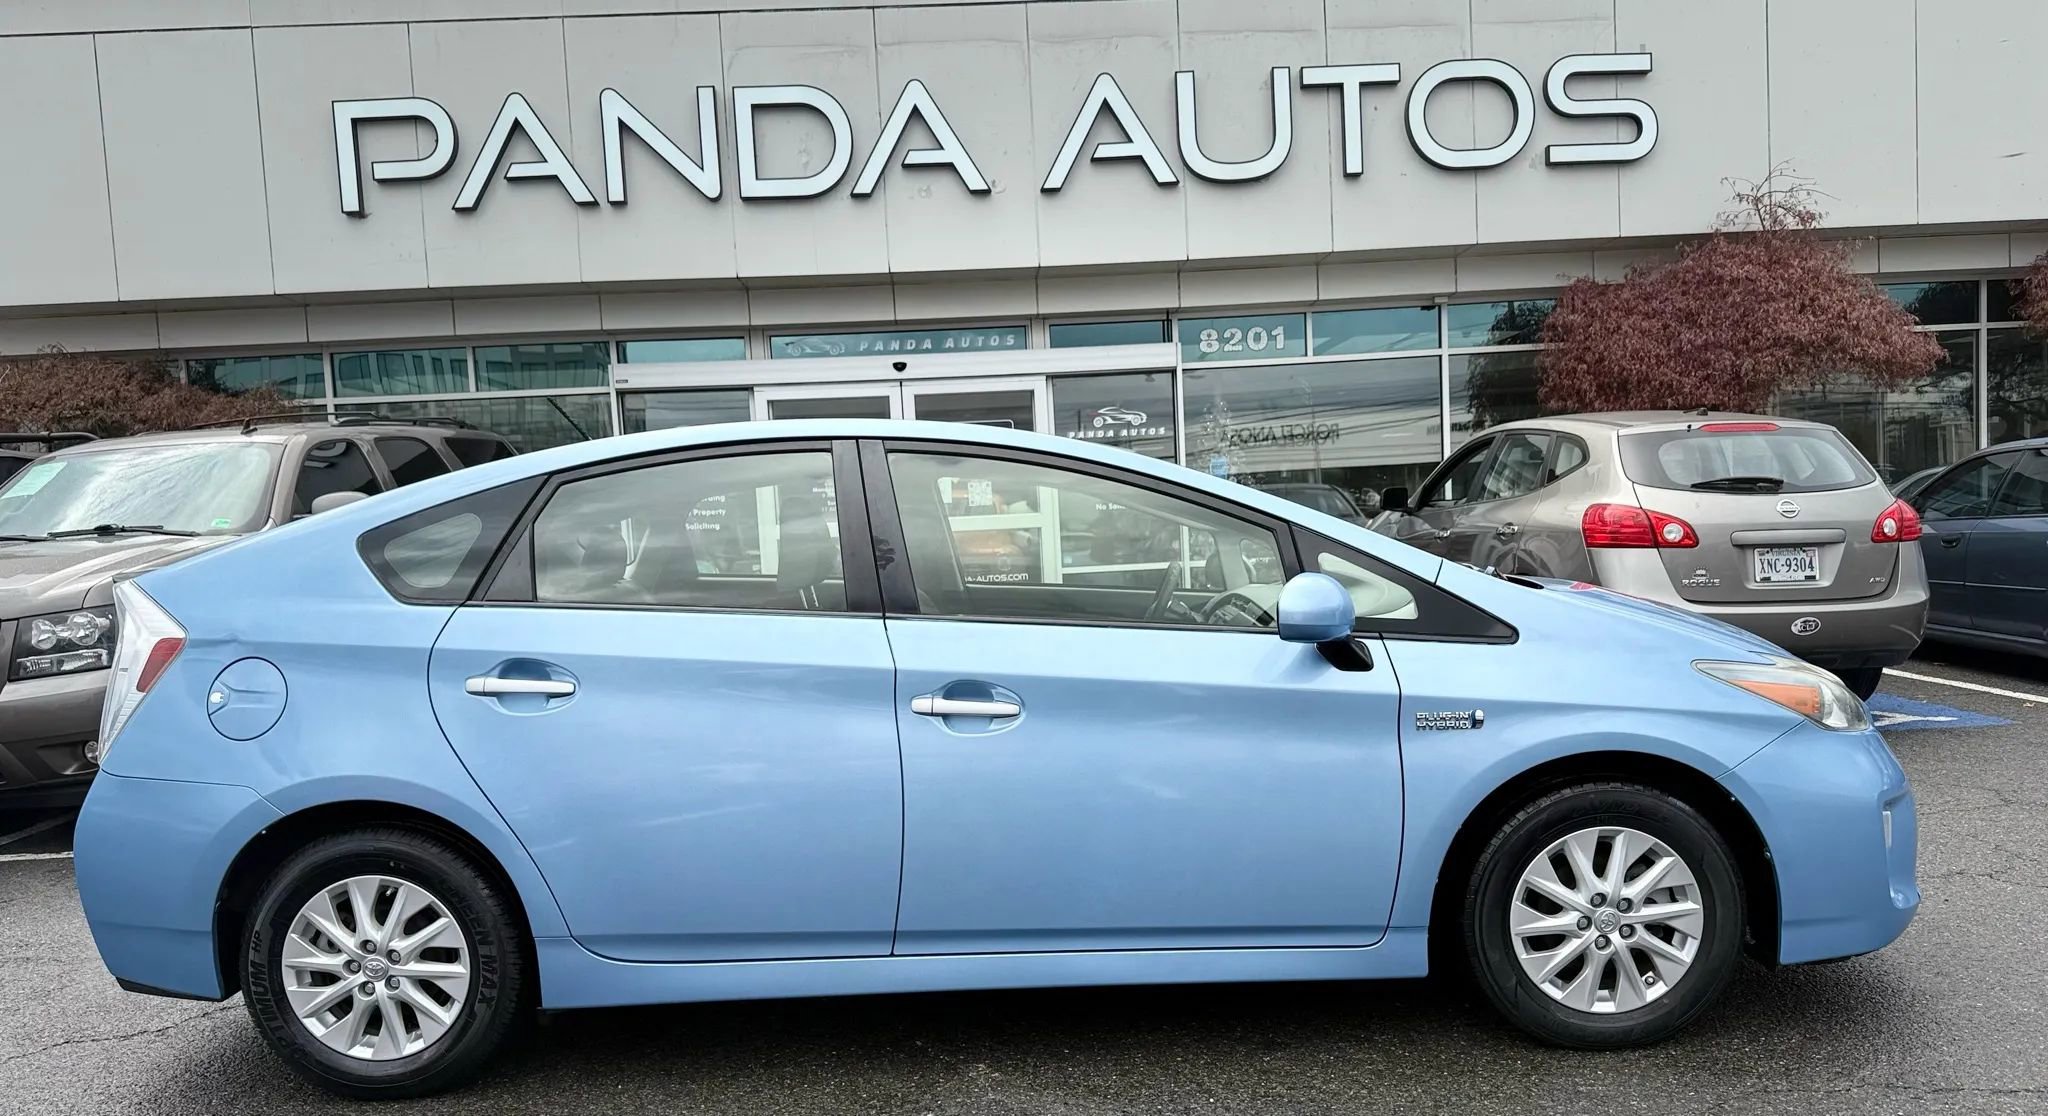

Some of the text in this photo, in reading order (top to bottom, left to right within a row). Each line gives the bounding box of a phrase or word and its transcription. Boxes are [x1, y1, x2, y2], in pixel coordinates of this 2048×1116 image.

[331, 52, 1659, 215] PANDA AUTOS
[860, 335, 1016, 352] PANDA AUTOS
[1198, 325, 1286, 354] 8201
[1067, 427, 1166, 439] PANDA AUTOS
[692, 508, 727, 517] Property
[1759, 557, 1815, 574] XNC-9304
[1681, 578, 1721, 587] ROGUE
[1416, 711, 1471, 721] PLUG-IN
[1416, 720, 1472, 730] HYBRID
[251, 930, 263, 954] HP
[477, 953, 499, 1010] MAX
